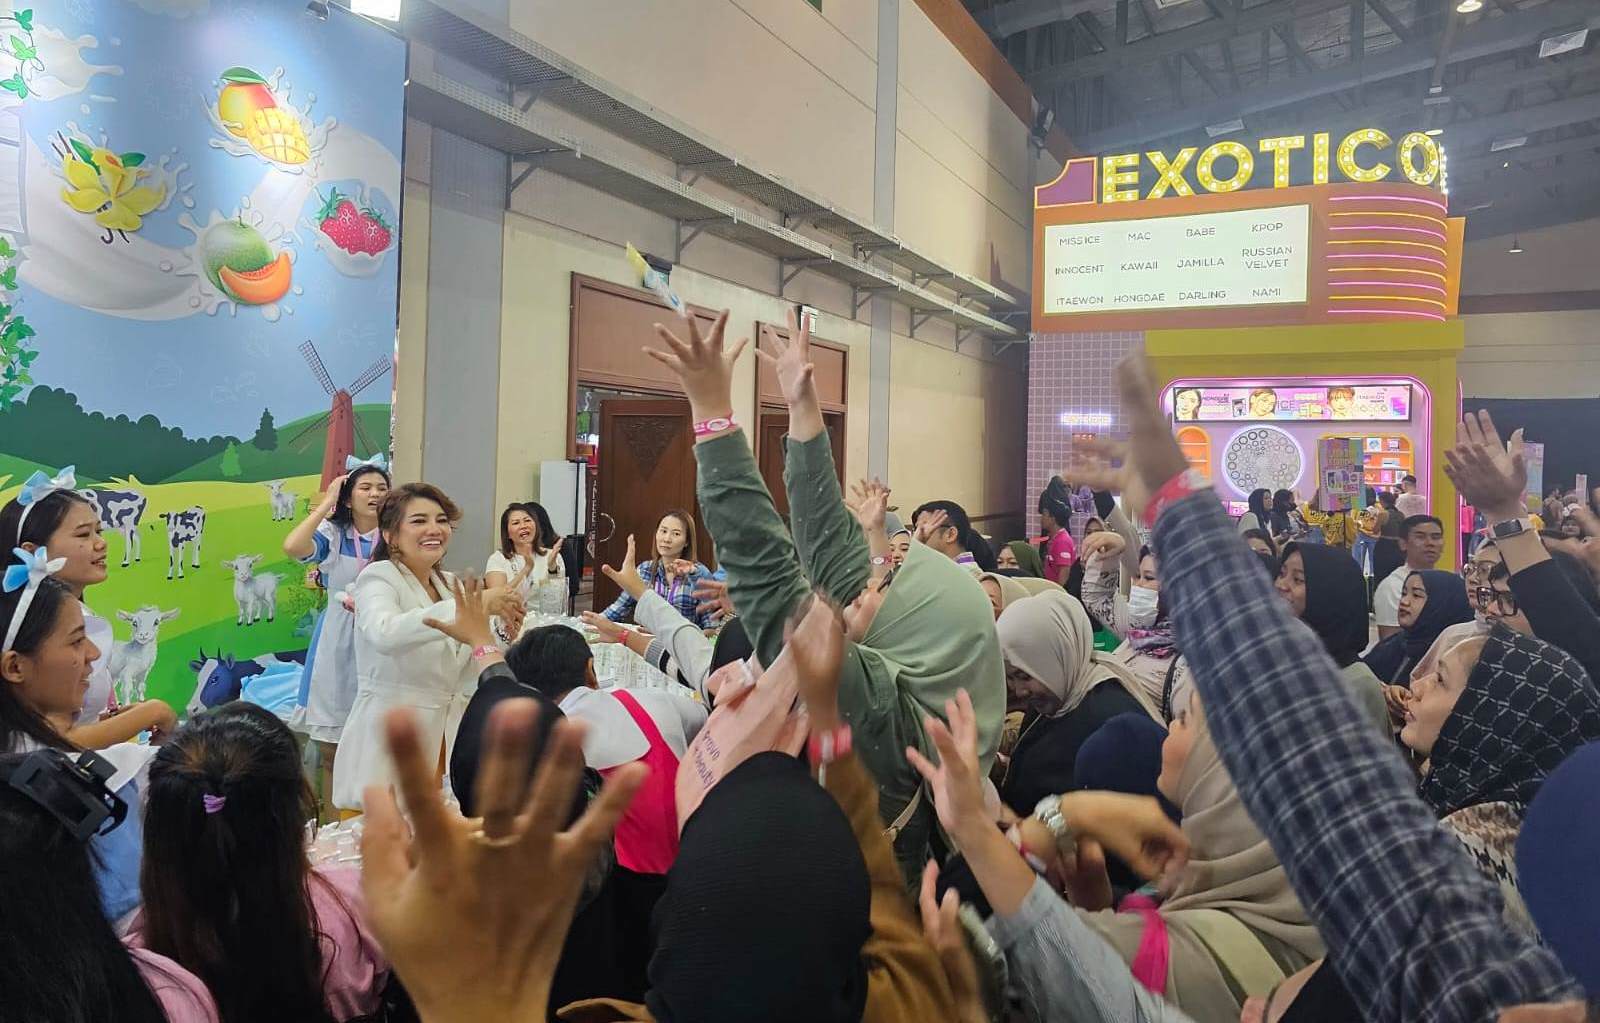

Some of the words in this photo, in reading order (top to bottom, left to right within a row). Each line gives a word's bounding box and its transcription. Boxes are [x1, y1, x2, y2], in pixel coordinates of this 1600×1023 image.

[1102, 128, 1440, 203] EXOTICO
[1185, 227, 1216, 238] BABE
[1251, 222, 1284, 233] KPOP
[1059, 236, 1084, 246] MISS
[1085, 235, 1101, 244] ICE
[1127, 231, 1152, 241] MAC
[1241, 246, 1293, 257] RUSSIAN
[1120, 262, 1158, 272] KAWAII
[1176, 257, 1225, 268] JAMILLA
[1244, 258, 1289, 269] VELVET
[1055, 264, 1105, 276] INNOCENT
[1178, 290, 1227, 301] DARLING
[1252, 287, 1281, 298] NAMI
[1056, 296, 1104, 306] ITAEWON
[1113, 293, 1165, 304] HONGDAE
